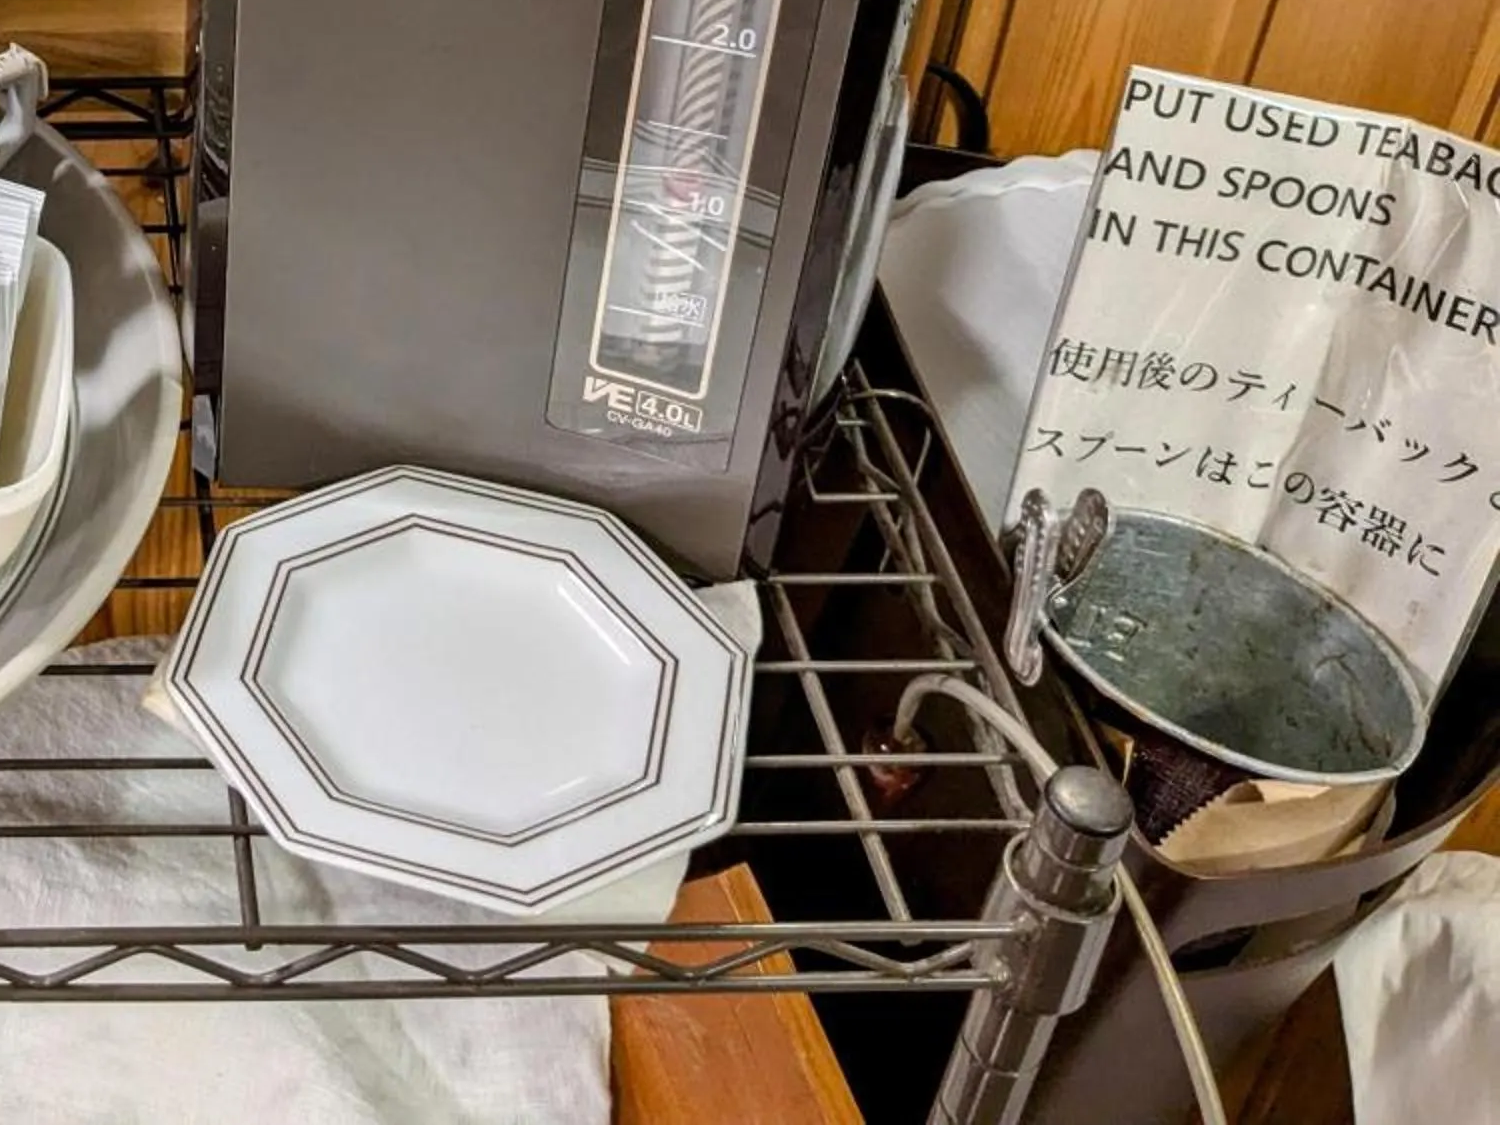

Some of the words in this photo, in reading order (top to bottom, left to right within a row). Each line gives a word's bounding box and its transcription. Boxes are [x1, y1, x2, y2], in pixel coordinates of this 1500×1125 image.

[711, 24, 757, 51] 2.0
[1124, 78, 1214, 124] PUT
[1224, 97, 1340, 148] USED
[688, 191, 725, 216] 1.0
[1103, 147, 1207, 190] AND
[1217, 166, 1397, 226] SPOONS
[1088, 208, 1137, 247] IN
[1153, 220, 1245, 263] THIS
[1256, 239, 1500, 345] CONTAINER
[642, 398, 695, 429] 4.0L
[1027, 426, 1446, 576] スプーンはこの容器に
